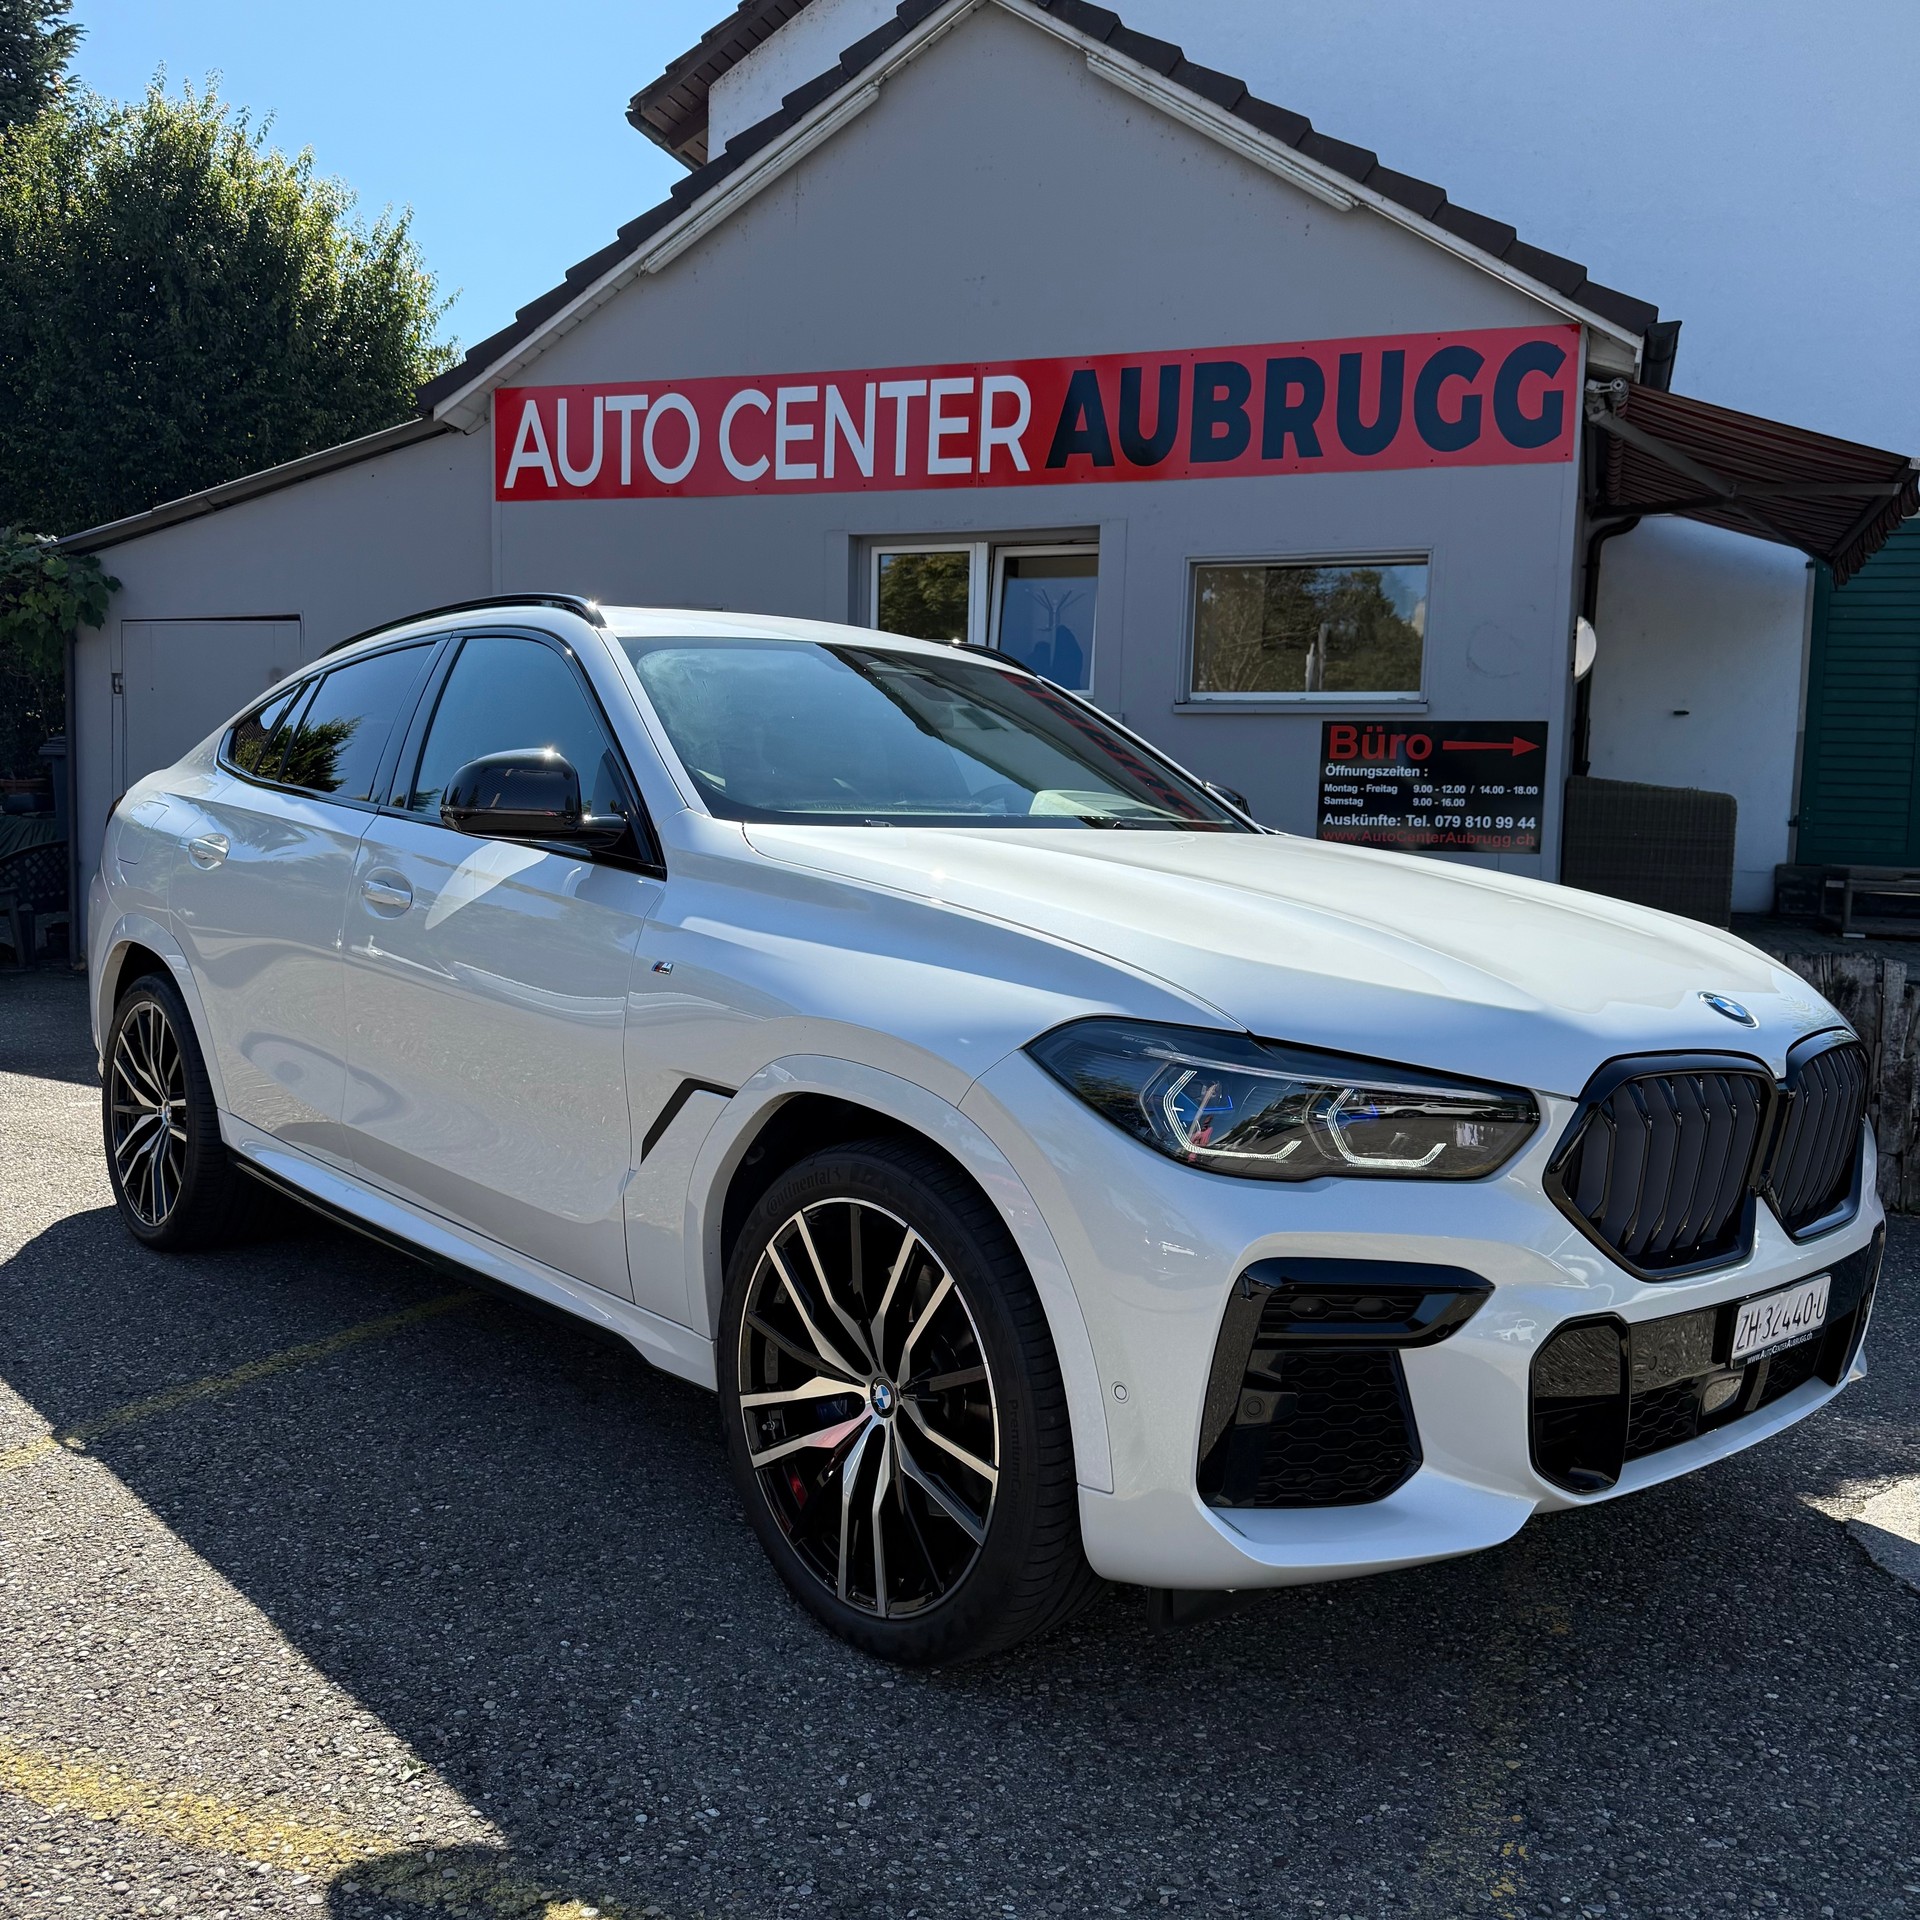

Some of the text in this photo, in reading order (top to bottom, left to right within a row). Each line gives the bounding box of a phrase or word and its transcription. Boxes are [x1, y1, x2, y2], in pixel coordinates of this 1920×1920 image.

[503, 340, 1568, 489] AUTO CENTER AUBRUGG
[1329, 725, 1433, 760] Büro
[1325, 763, 1420, 778] Öffnungszeiten
[1324, 784, 1358, 794] Montag
[1366, 784, 1398, 795] Freitag
[1413, 785, 1433, 794] 9.00
[1441, 785, 1466, 795] 12.00
[1479, 785, 1504, 795] 14.00
[1513, 786, 1538, 796] 18.00
[1324, 797, 1364, 807] Samstag
[1413, 798, 1432, 807] 9.00
[1441, 798, 1465, 807] 16.00
[1323, 813, 1536, 829] Auskünfte: Tel. 079 810 99 44
